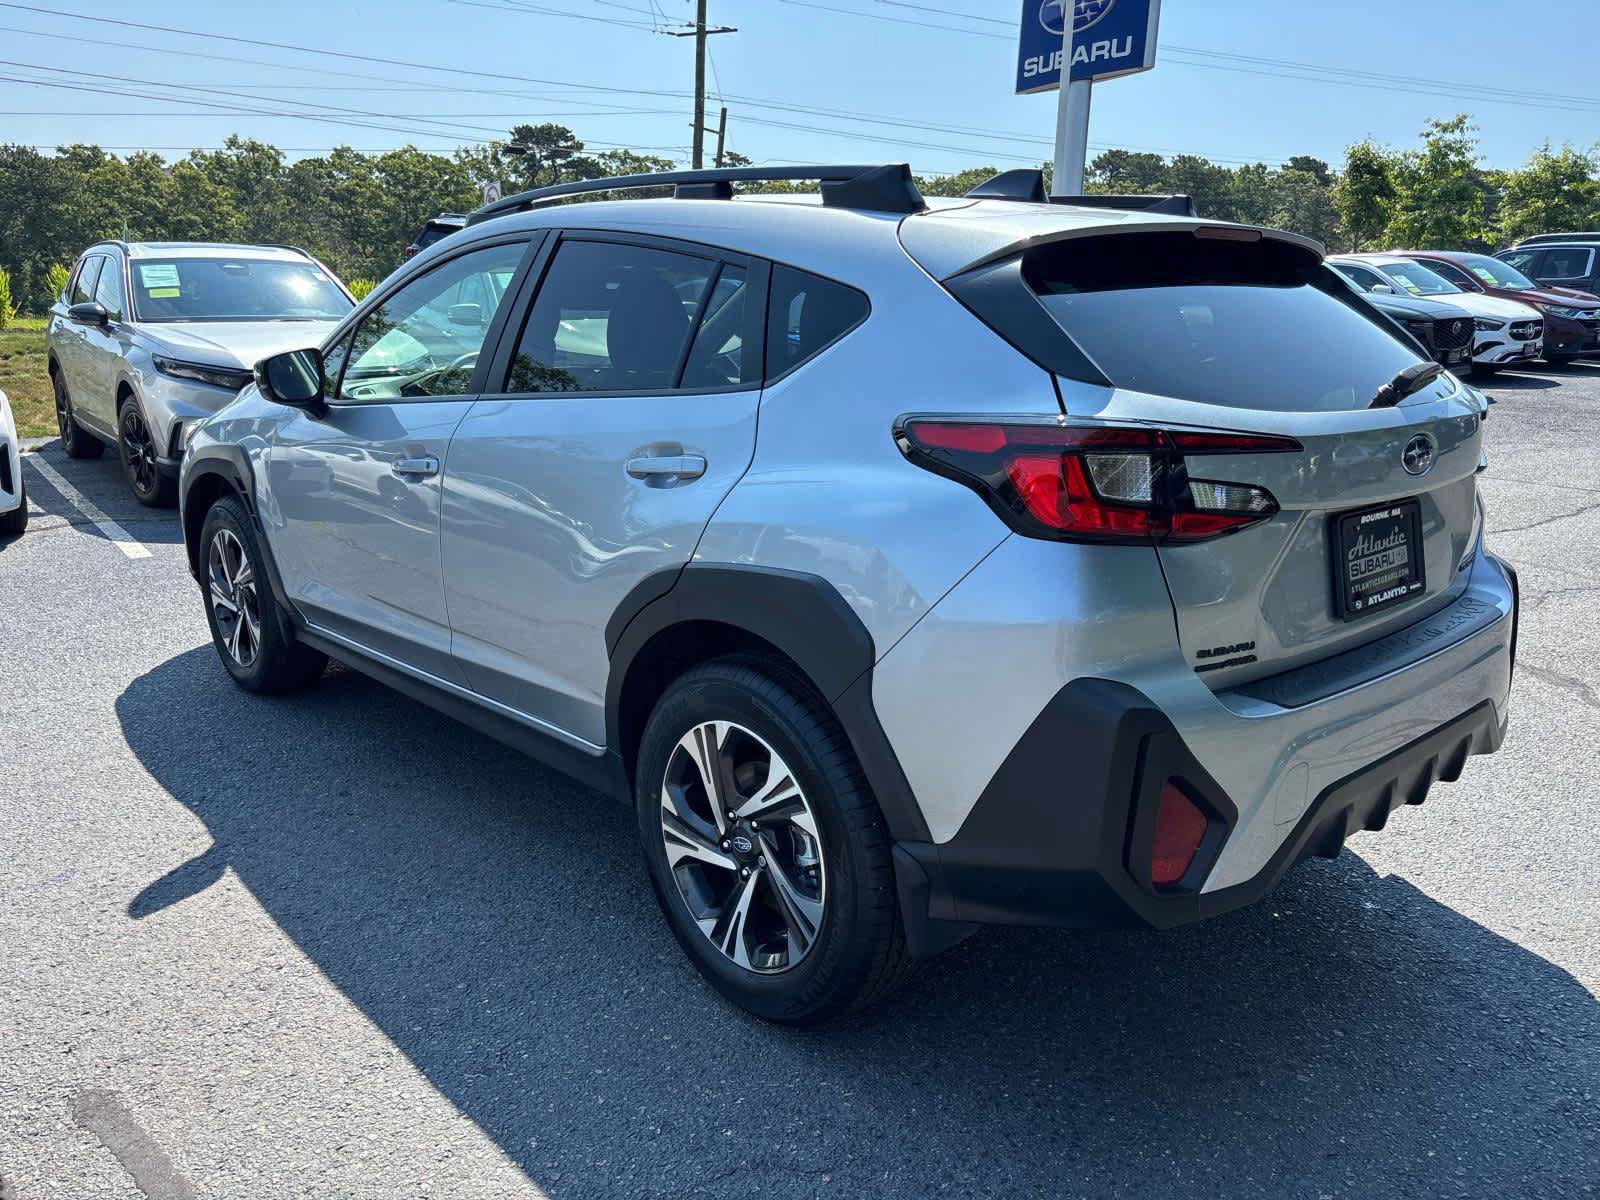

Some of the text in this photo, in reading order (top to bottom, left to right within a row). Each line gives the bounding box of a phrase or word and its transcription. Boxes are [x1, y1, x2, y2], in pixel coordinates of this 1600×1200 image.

[1348, 525, 1407, 560] Atlantic
[1350, 550, 1396, 578] SUBARU
[1368, 586, 1407, 606] ATLANTIC
[1196, 641, 1256, 658] SUBARU
